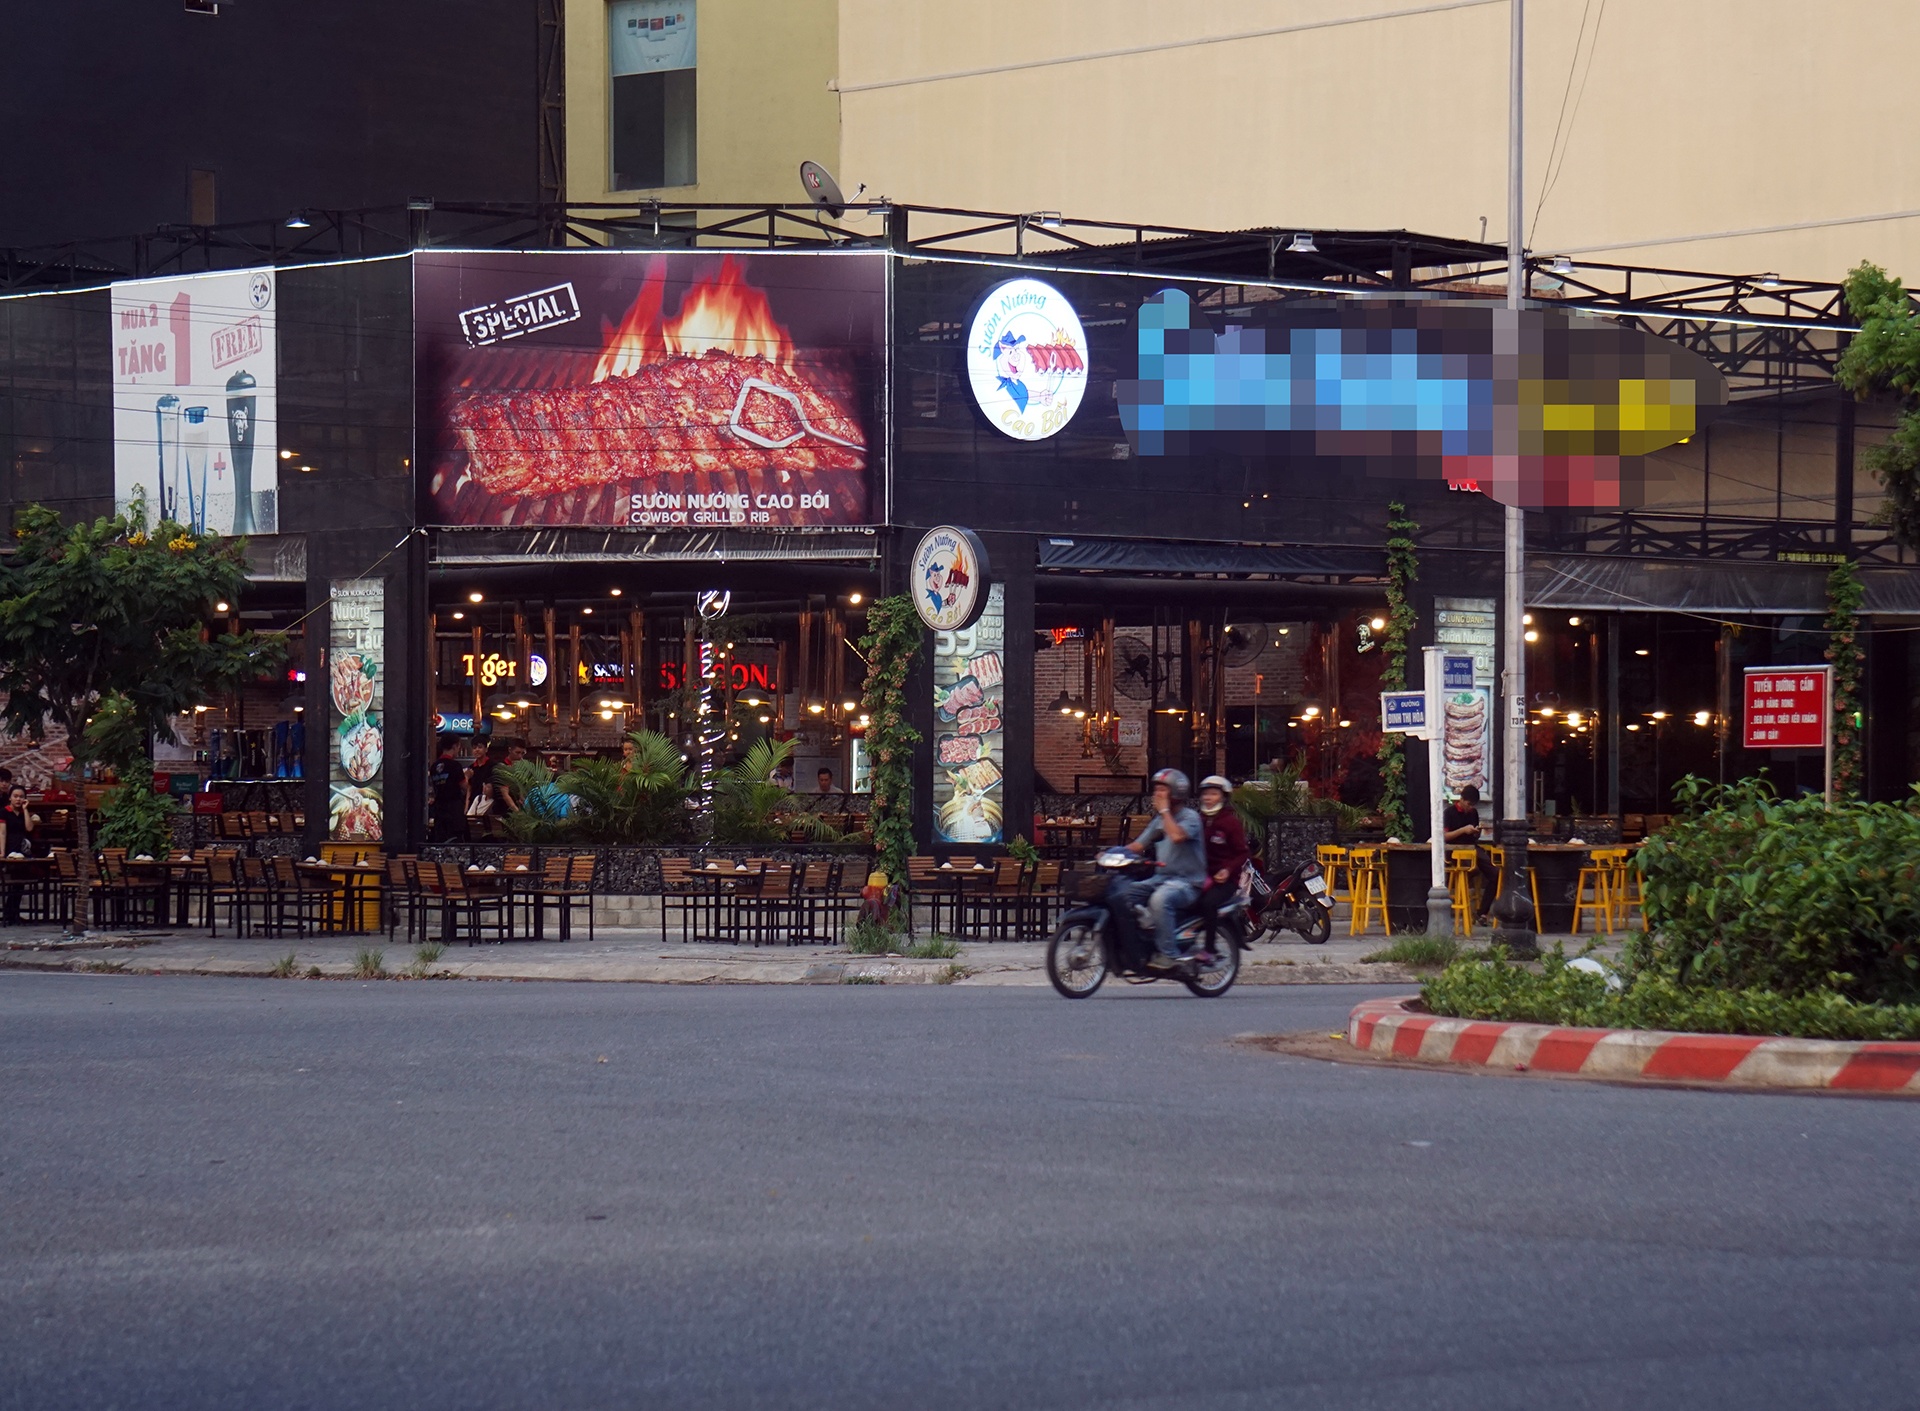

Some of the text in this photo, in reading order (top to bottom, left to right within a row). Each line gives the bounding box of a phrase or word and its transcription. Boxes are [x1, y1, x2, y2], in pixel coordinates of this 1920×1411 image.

[121, 303, 159, 330] MUA 2
[472, 294, 567, 339] SPECIAL
[979, 289, 1047, 358] Sườn Nướng
[169, 291, 191, 386] 1
[215, 322, 259, 363] FREE
[118, 339, 167, 385] TẶNG
[1001, 397, 1069, 436] Cao Bồi
[631, 489, 830, 509] SƯỜN NƯỚNG CAO BỒI
[631, 511, 770, 523] COWBOY GRILLED RIB
[925, 606, 943, 624] Cao
